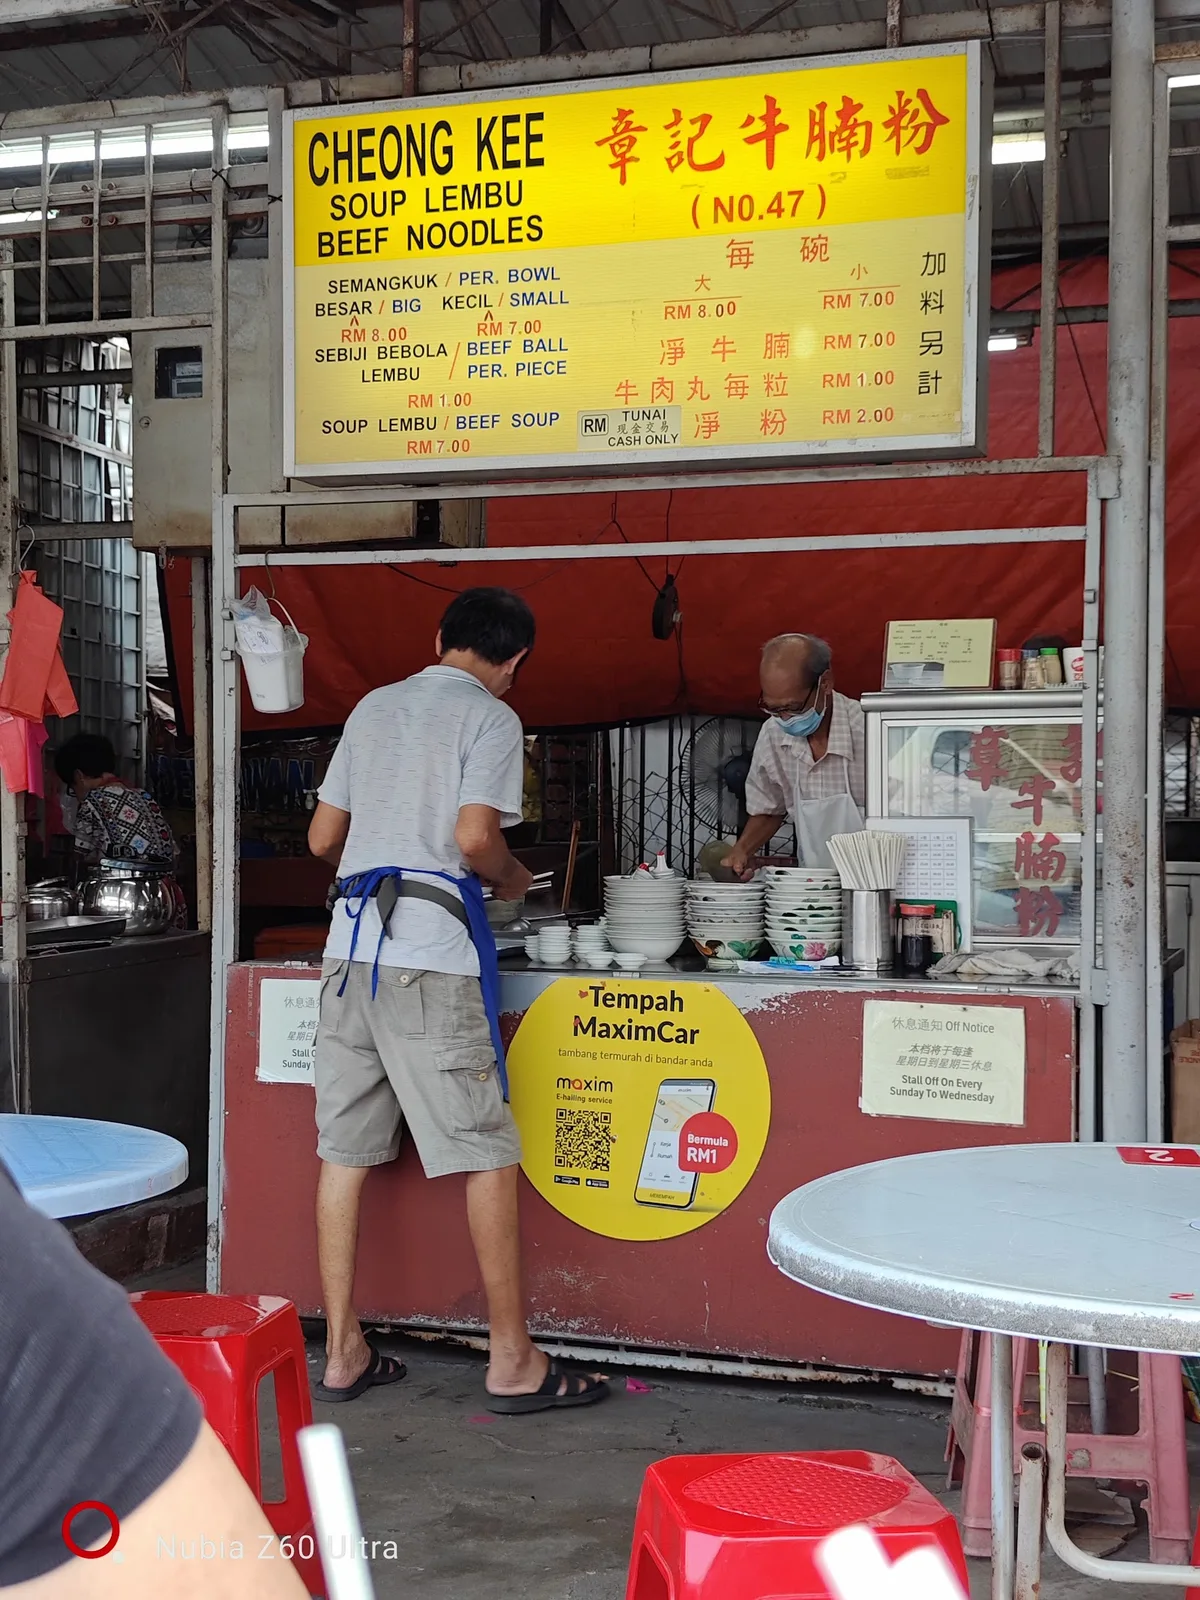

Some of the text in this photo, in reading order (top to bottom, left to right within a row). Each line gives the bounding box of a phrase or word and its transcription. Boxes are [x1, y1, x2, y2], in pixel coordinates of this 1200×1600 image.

[308, 112, 545, 187] CHEONG KEE
[330, 179, 523, 221] SOUP LEMBU
[317, 214, 544, 258] BEEF NOODLES
[327, 273, 438, 295] SEMANGKUK
[459, 270, 500, 286] PER.
[507, 266, 561, 283] BOWL
[849, 262, 869, 281] 小
[694, 274, 711, 293] 大
[314, 300, 373, 317] BESAR
[392, 298, 422, 314] BIG
[442, 293, 494, 311] KECIL
[509, 290, 570, 307] SMALL
[823, 290, 896, 310] RM 7.00
[663, 300, 737, 321] RM 8.00
[341, 326, 408, 343] RM 8.00
[477, 319, 542, 337] RM 7.00
[823, 330, 897, 350] RM 7.00
[314, 346, 368, 363] SEBIJI
[377, 343, 448, 361] BEBOLA
[467, 340, 512, 356] BEEF
[522, 337, 569, 353] BALL
[361, 359, 568, 384] LEMBU PER. PIECE
[821, 369, 896, 389] RM 1.00
[408, 392, 472, 408] RM 1.00
[321, 418, 369, 435] SOUP
[378, 416, 438, 433] LEMBU
[456, 414, 501, 430] BEEF
[511, 411, 561, 429] SOUP
[621, 408, 667, 422] TUNAI
[821, 405, 896, 425] RM 2.00
[583, 417, 607, 434] RM
[406, 437, 471, 455] RM 7.00
[607, 433, 679, 447] CASH ONLY
[589, 985, 684, 1015] Tempah
[572, 1015, 700, 1045] MaximCar
[945, 1020, 960, 1032] Off
[963, 1022, 995, 1034] Notice
[291, 1048, 310, 1058] Stall
[558, 1048, 713, 1068] tambang termurah di bandar anda
[282, 1060, 311, 1071] Sunday
[556, 1076, 613, 1092] maxim
[902, 1074, 983, 1091] Stall Off On Every
[587, 1096, 613, 1104] service
[890, 1086, 995, 1105] Sunday To Wednesday
[687, 1133, 729, 1147] Bermula
[686, 1147, 717, 1164] RM1
